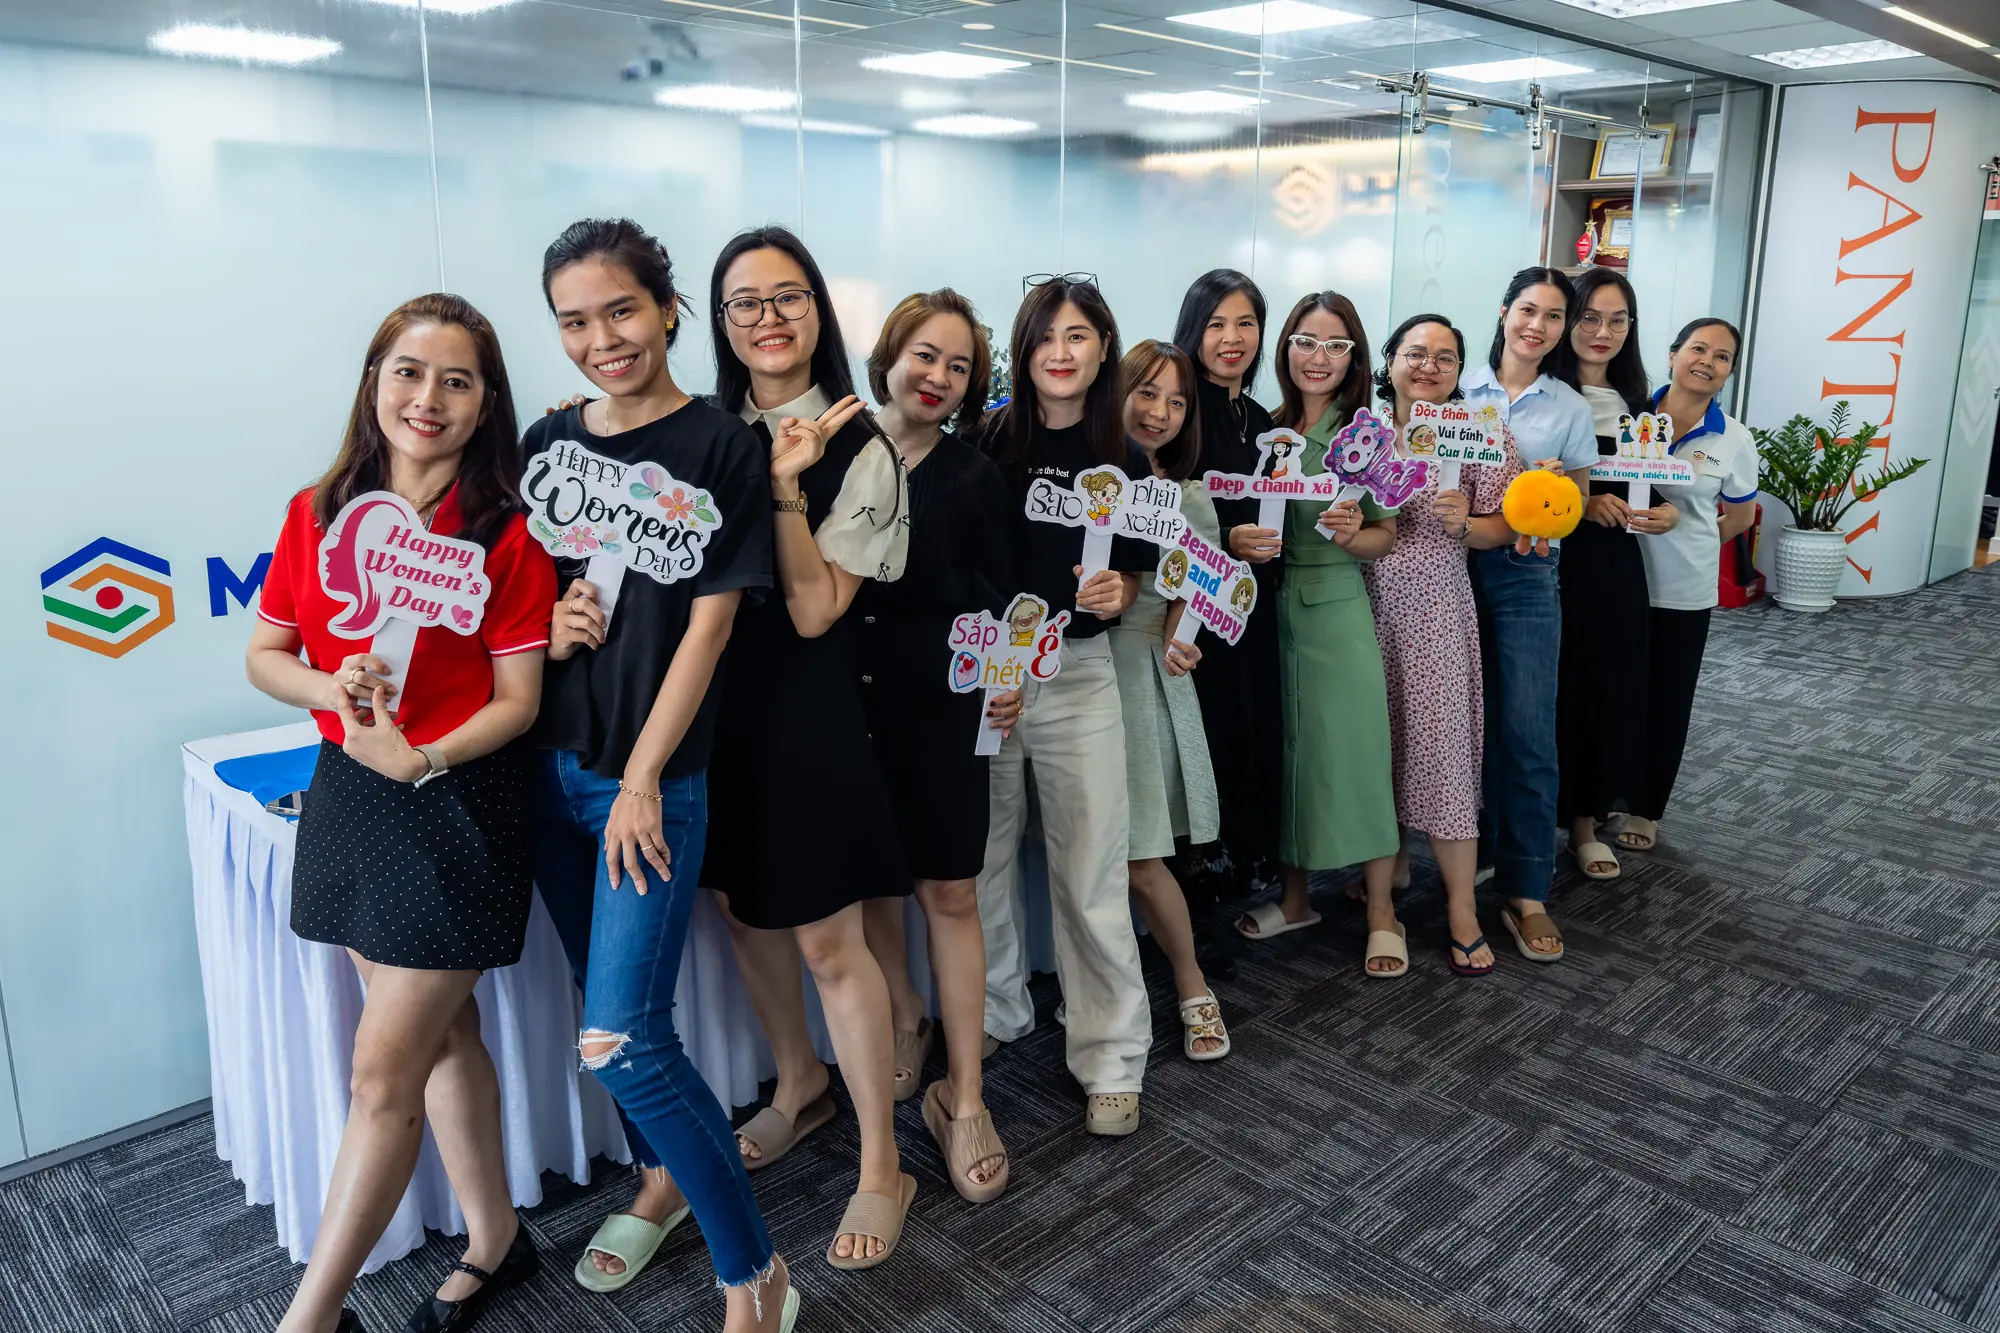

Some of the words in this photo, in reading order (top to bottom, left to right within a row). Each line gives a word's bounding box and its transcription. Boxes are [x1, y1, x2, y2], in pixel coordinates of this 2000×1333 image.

[1415, 404, 1437, 420] Độc
[1442, 407, 1469, 420] thân
[1341, 425, 1380, 473] 8
[1438, 425, 1455, 439] Vui
[1460, 427, 1483, 442] tính
[556, 445, 628, 487] Happy
[1438, 444, 1460, 458] Cua
[1463, 446, 1475, 459] là
[1478, 447, 1502, 462] dính
[1044, 466, 1055, 475] the
[1055, 467, 1069, 478] best
[1208, 476, 1245, 496] Đẹp
[1252, 479, 1304, 494] chanh
[1312, 478, 1333, 494] xả
[1367, 446, 1417, 498] March
[1613, 469, 1639, 479] trong
[528, 457, 702, 572] Women's
[1030, 481, 1083, 520] Sao
[1132, 479, 1177, 509] phải
[1122, 509, 1183, 540] xoắn?
[385, 524, 476, 569] Happy
[634, 546, 678, 581] Day
[1178, 526, 1236, 582] Beauty
[364, 548, 483, 596] Women's
[1187, 563, 1222, 597] and
[387, 585, 444, 621] Day
[1190, 590, 1243, 641] Happy
[952, 614, 998, 653] Sắp
[983, 655, 1024, 685] hết
